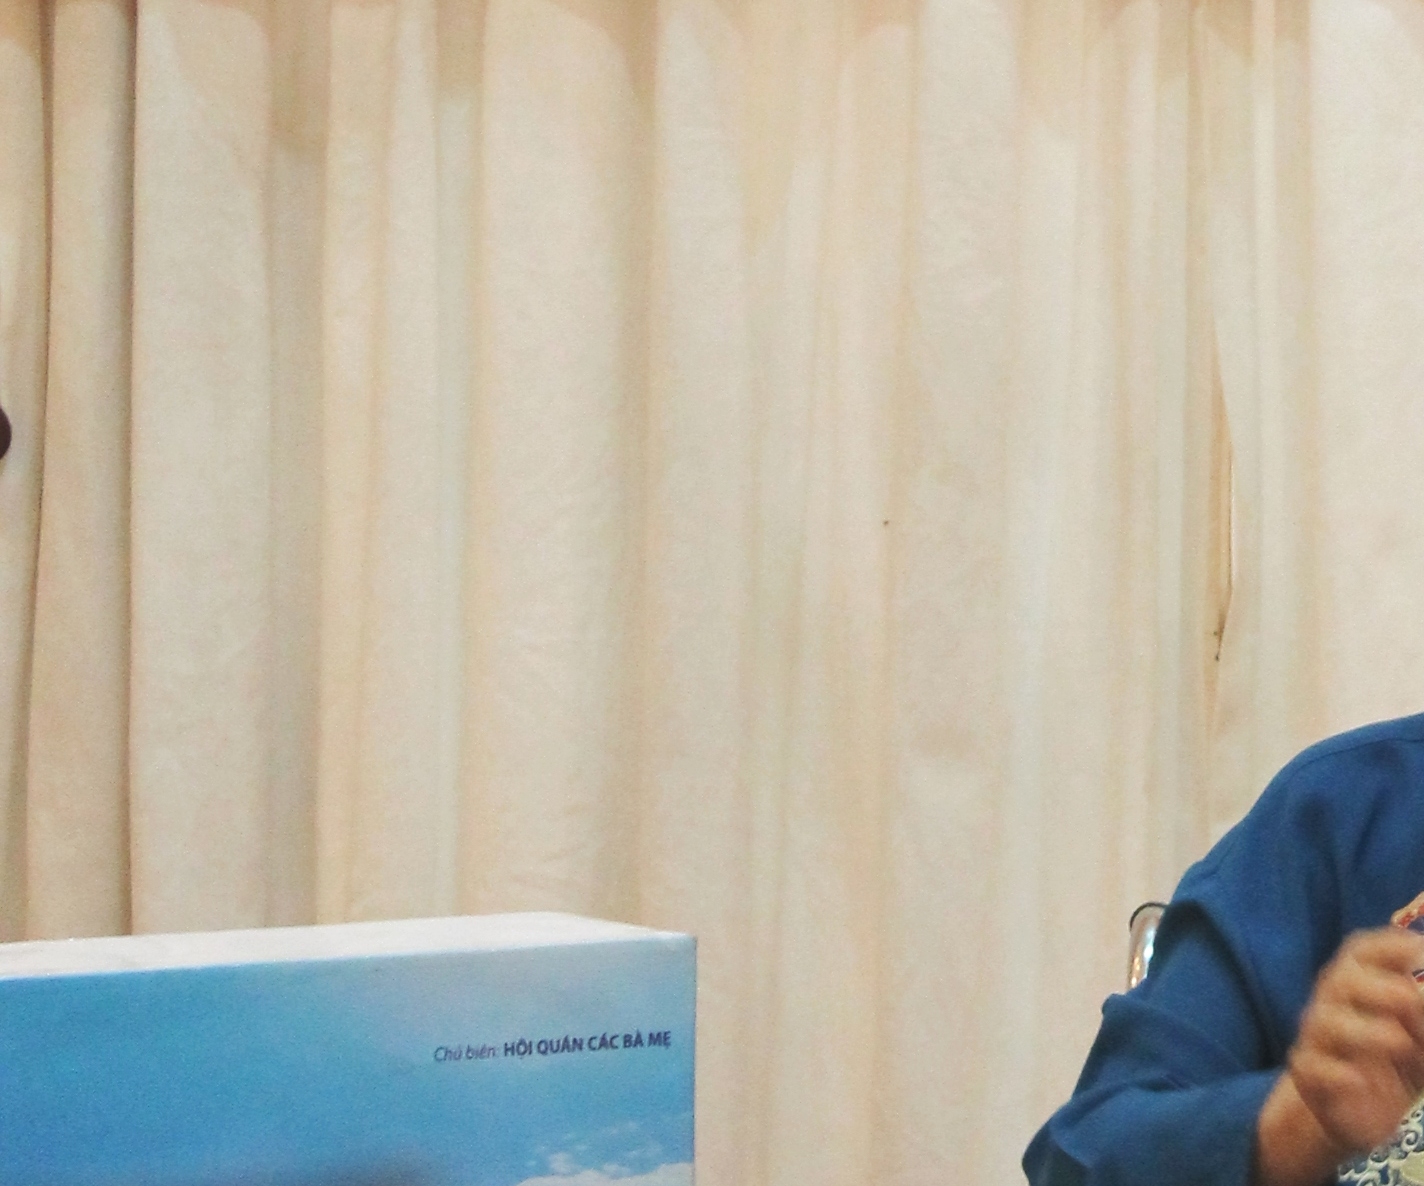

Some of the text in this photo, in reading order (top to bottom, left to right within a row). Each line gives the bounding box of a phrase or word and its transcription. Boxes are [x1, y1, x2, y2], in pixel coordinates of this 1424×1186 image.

[503, 1038, 532, 1059] HỘI
[587, 1031, 619, 1051] CÁC
[623, 1029, 644, 1049] BÀ
[648, 1030, 672, 1049] MẸ
